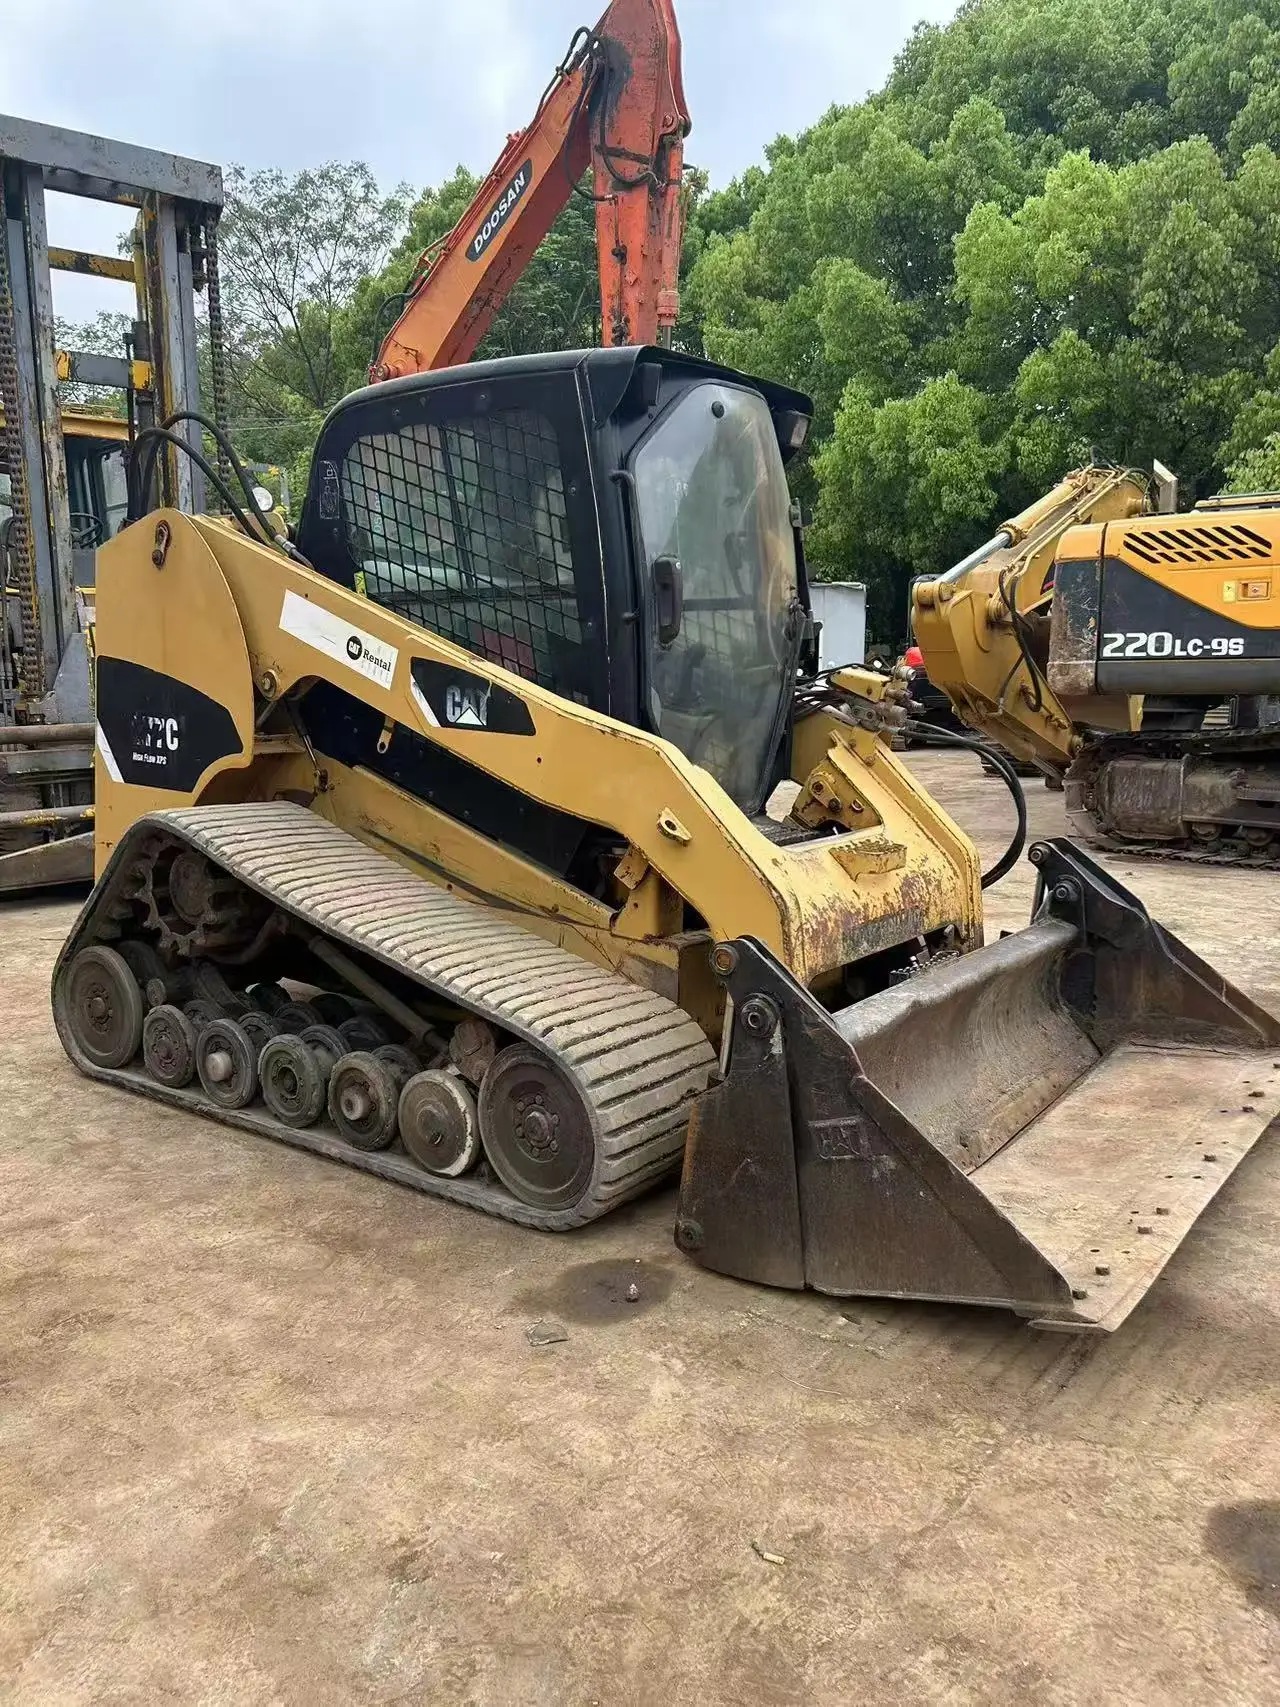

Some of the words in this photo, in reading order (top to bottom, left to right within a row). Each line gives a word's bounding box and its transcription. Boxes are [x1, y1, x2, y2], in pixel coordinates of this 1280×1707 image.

[473, 171, 526, 254] DOOSAN
[362, 648, 392, 672] Rental
[446, 685, 490, 726] CAT
